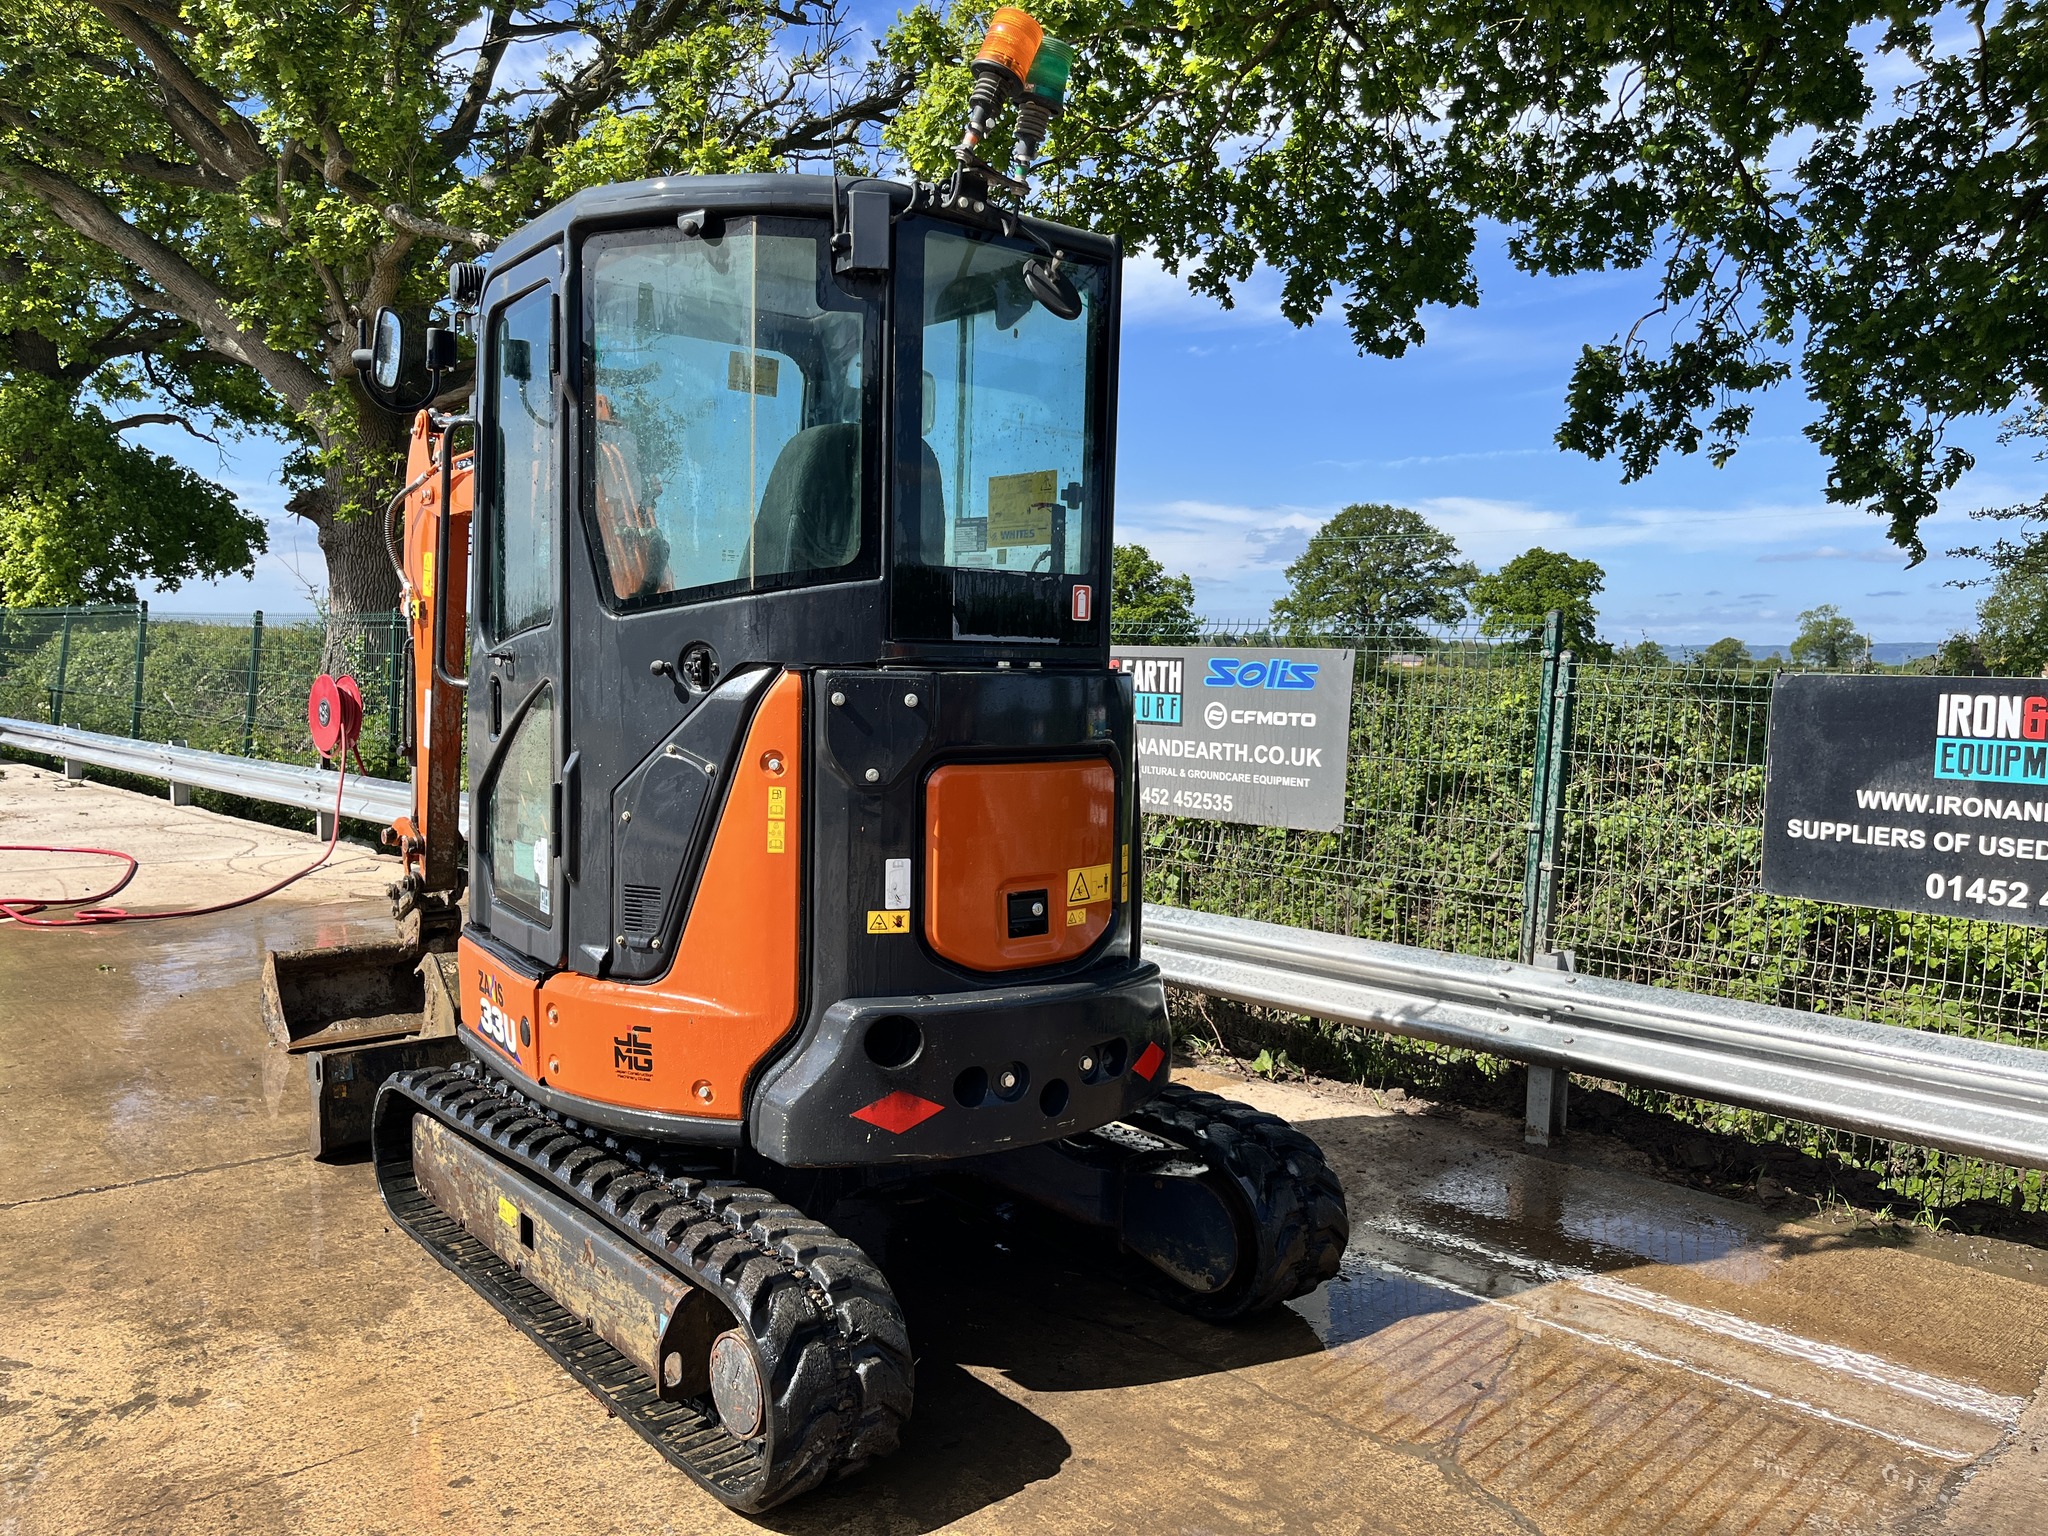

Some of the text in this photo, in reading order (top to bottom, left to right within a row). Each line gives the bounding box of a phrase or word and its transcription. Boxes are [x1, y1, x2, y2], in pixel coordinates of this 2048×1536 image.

[1135, 696, 1178, 720] URF
[1231, 709, 1317, 727] CFMOTO
[1179, 768, 1186, 778] &
[1187, 769, 1251, 784] GROUNDCARE
[1252, 774, 1311, 788] EQUIPMENT
[1940, 742, 2048, 779] EQUIPM
[1140, 786, 1234, 813] 452 452535
[1787, 818, 1926, 850] SUPPLIERS
[1933, 831, 1971, 853] OF
[1925, 872, 2029, 909] 01452
[477, 968, 505, 1008] ZAXIS
[479, 996, 517, 1053] 33U
